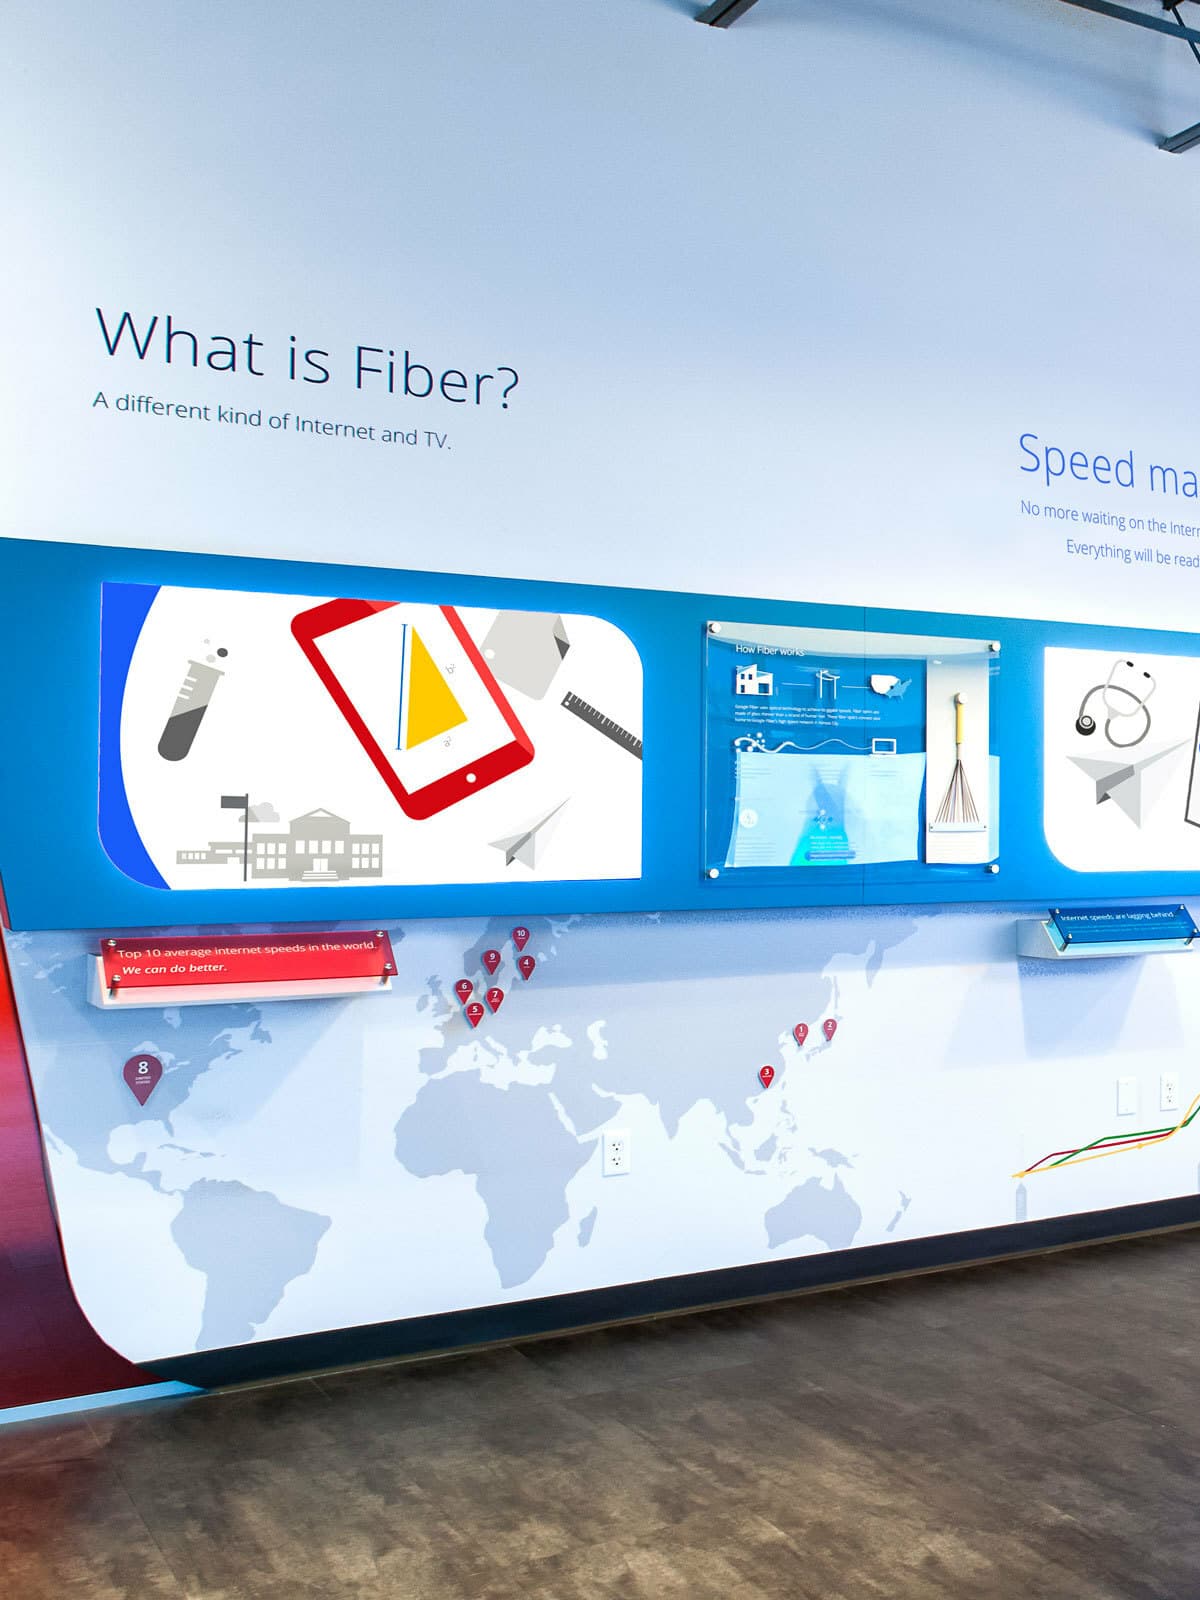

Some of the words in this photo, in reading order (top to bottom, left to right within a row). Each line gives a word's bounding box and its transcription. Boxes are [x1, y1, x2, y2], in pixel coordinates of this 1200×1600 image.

[96, 307, 264, 376] What
[288, 335, 330, 384] is
[356, 345, 519, 409] Fiber?
[92, 391, 109, 408] A
[115, 391, 211, 422] different
[217, 404, 262, 428] kind
[268, 412, 290, 430] of
[296, 415, 375, 442] Internet
[381, 428, 418, 447] and
[424, 431, 452, 450] TV.
[1019, 433, 1135, 488] Speed
[1021, 500, 1040, 516] No
[1044, 505, 1079, 521] more
[1082, 511, 1126, 532] waiting
[1129, 516, 1145, 529] on
[1147, 517, 1167, 533] the
[1066, 538, 1132, 564] Everything
[1134, 548, 1153, 563] will
[1156, 549, 1171, 565] be
[736, 642, 755, 654] How
[757, 645, 779, 655] Fiber
[117, 949, 142, 961] Top
[146, 948, 161, 958] 10
[164, 948, 211, 960] average
[214, 945, 262, 956] internet
[264, 944, 306, 956] speeds
[309, 942, 319, 952] in
[321, 941, 340, 951] the
[342, 940, 377, 951] world.
[122, 965, 142, 975] We
[145, 966, 167, 974] can
[170, 964, 186, 974] do
[189, 963, 227, 973] better.
[461, 982, 467, 990] 6
[492, 990, 498, 998] 7
[472, 1005, 478, 1013] 5
[138, 1061, 149, 1074] 8
